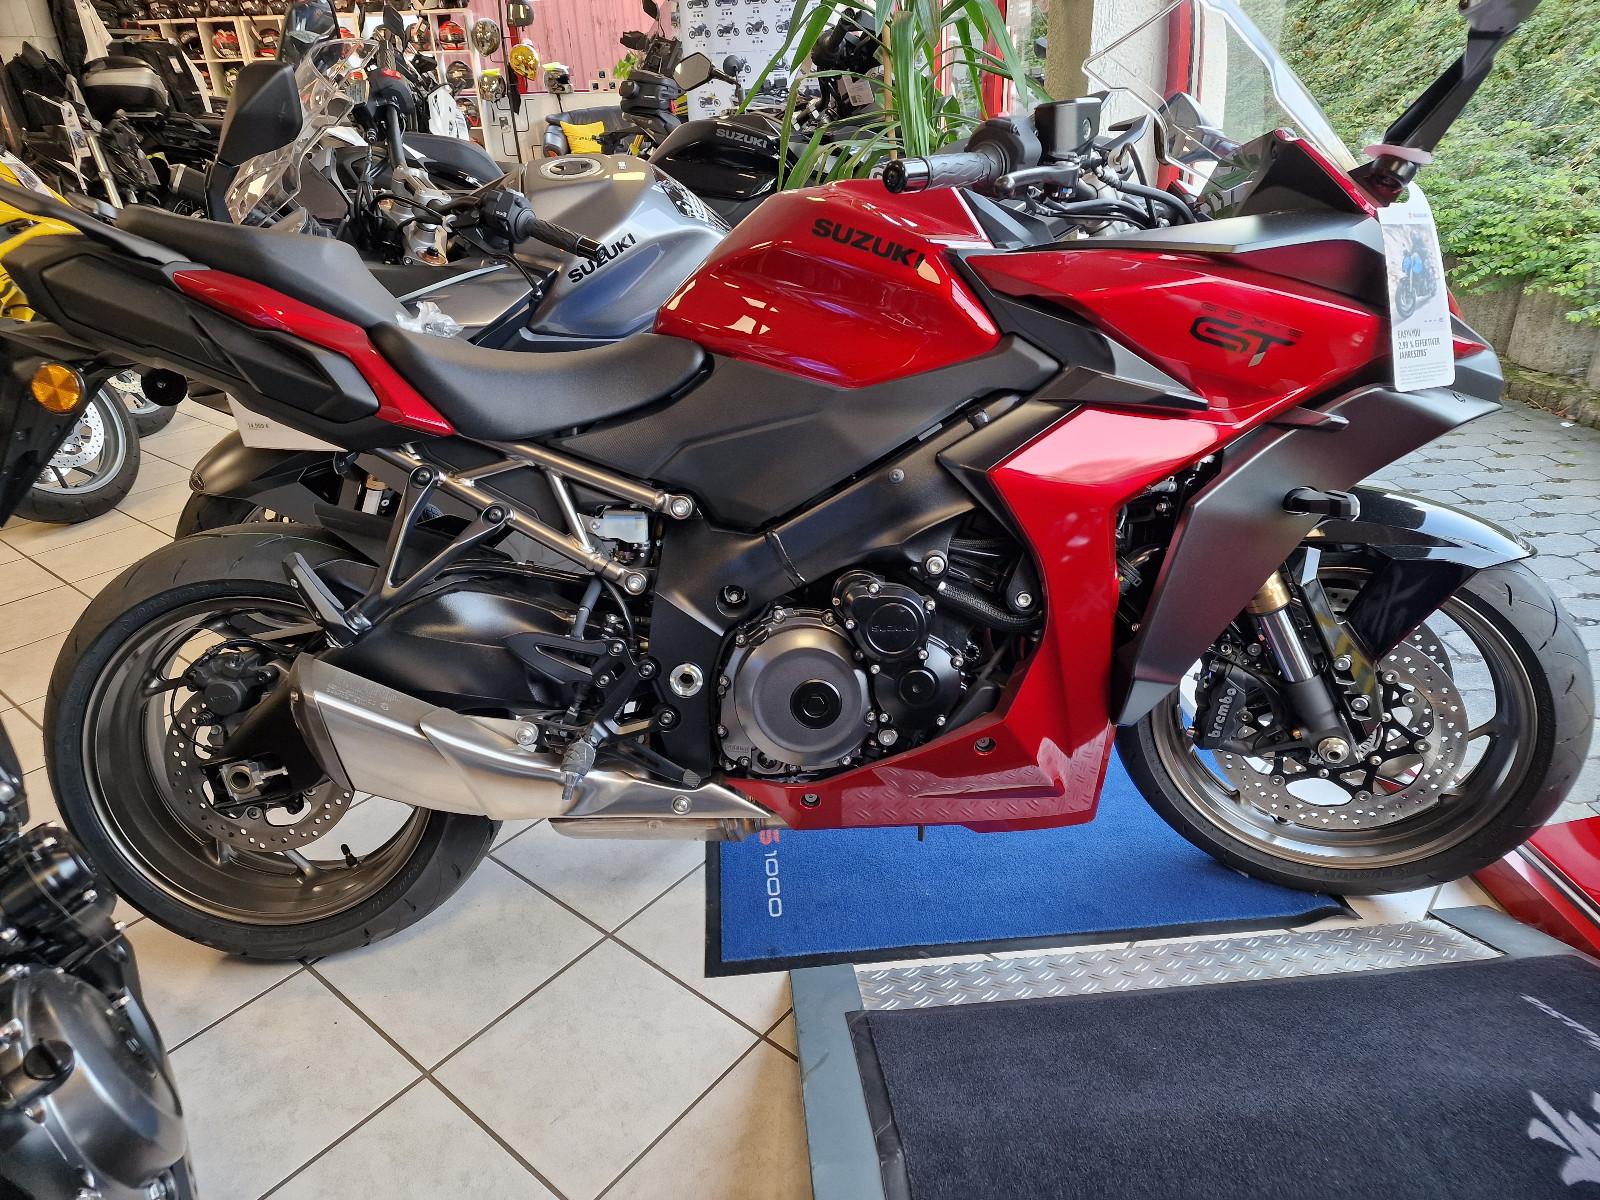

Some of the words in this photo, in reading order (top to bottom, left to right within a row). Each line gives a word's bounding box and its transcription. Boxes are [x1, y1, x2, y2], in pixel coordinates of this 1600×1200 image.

[715, 128, 768, 149] SUZUKI
[811, 218, 926, 270] SUZUKI
[1189, 316, 1297, 368] GT
[1207, 687, 1237, 738] brembo
[764, 850, 783, 918] 1000
